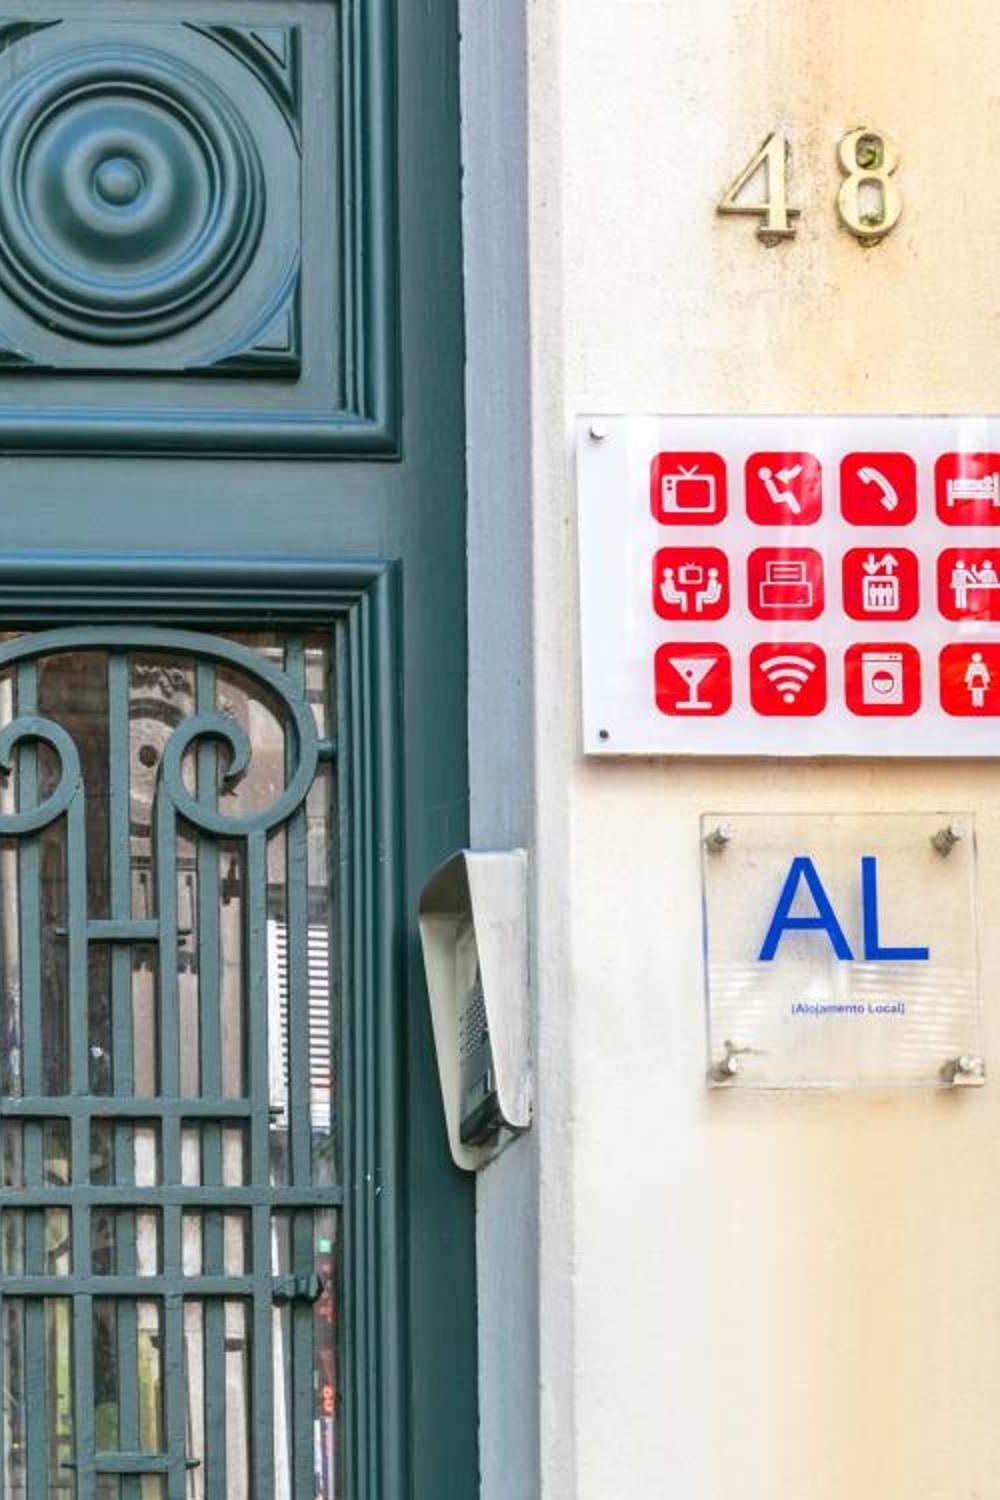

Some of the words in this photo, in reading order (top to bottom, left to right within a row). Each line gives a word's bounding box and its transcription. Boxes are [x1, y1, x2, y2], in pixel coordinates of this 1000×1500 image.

[716, 126, 903, 240] 48
[758, 855, 931, 961] AL
[791, 1002, 865, 1018] (Alojamento
[867, 1001, 905, 1016] Local)
